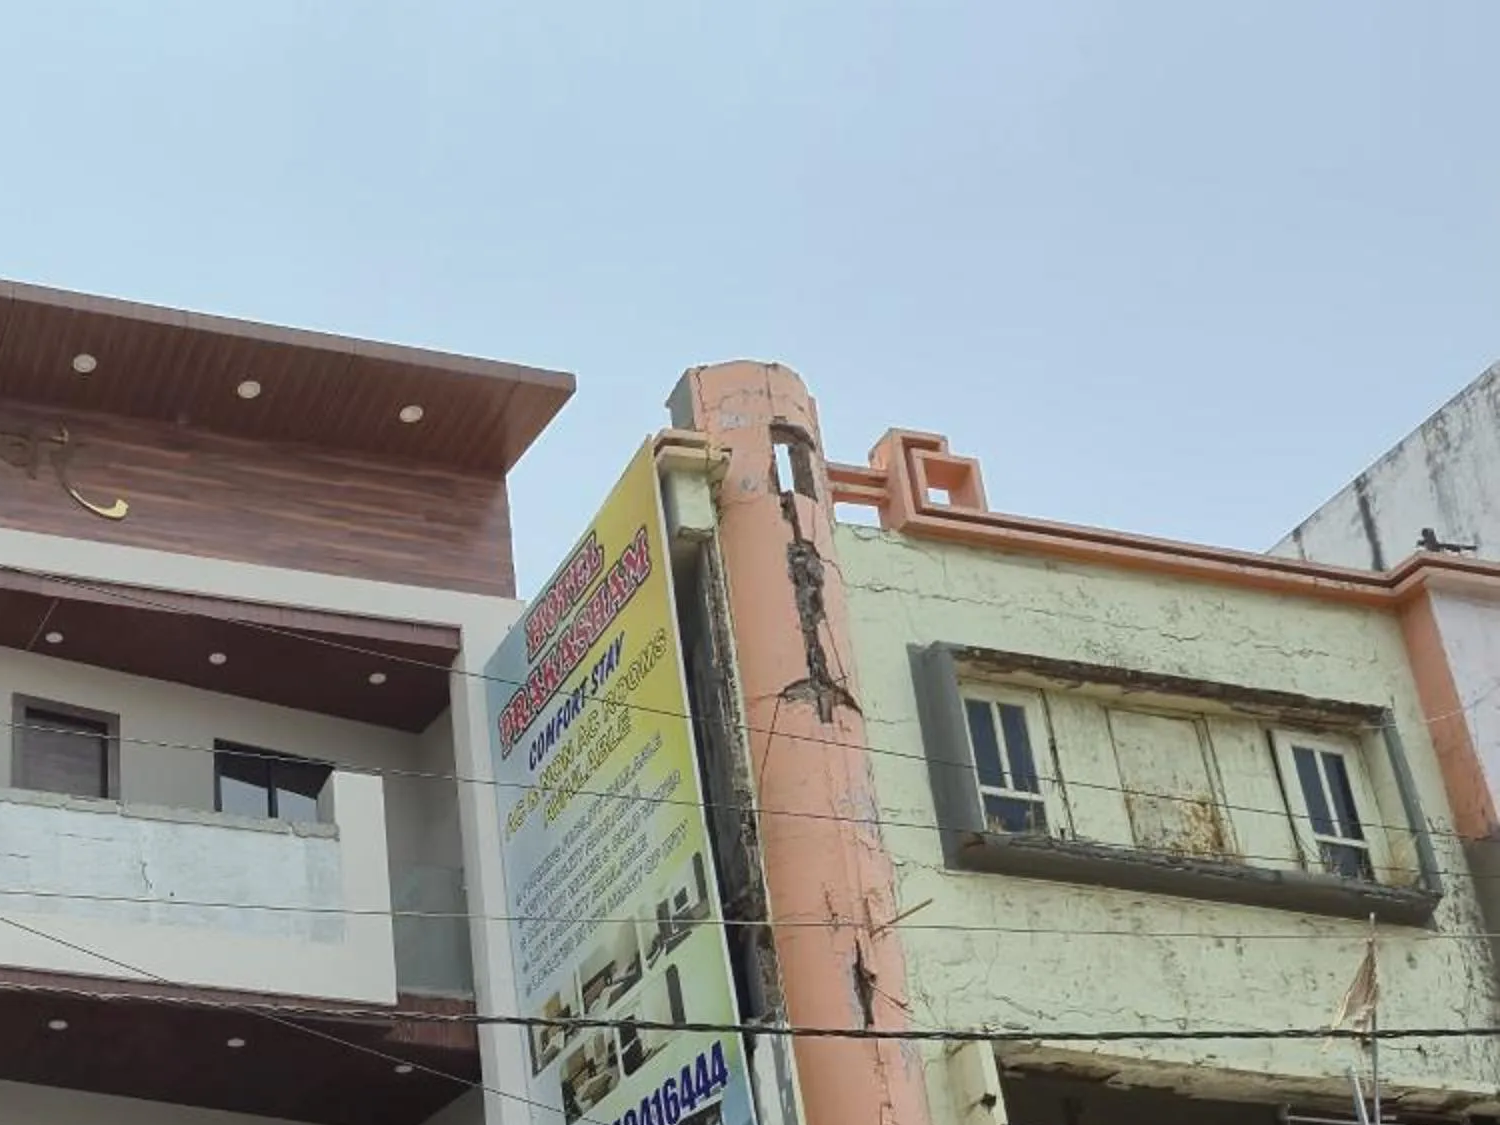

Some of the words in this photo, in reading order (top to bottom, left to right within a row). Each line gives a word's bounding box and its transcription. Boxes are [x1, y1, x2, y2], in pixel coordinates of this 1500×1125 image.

[499, 525, 651, 759] PRAKASHAM
[525, 529, 604, 664] HOTEL
[529, 675, 587, 770] COMFORT
[591, 632, 625, 696] STAY
